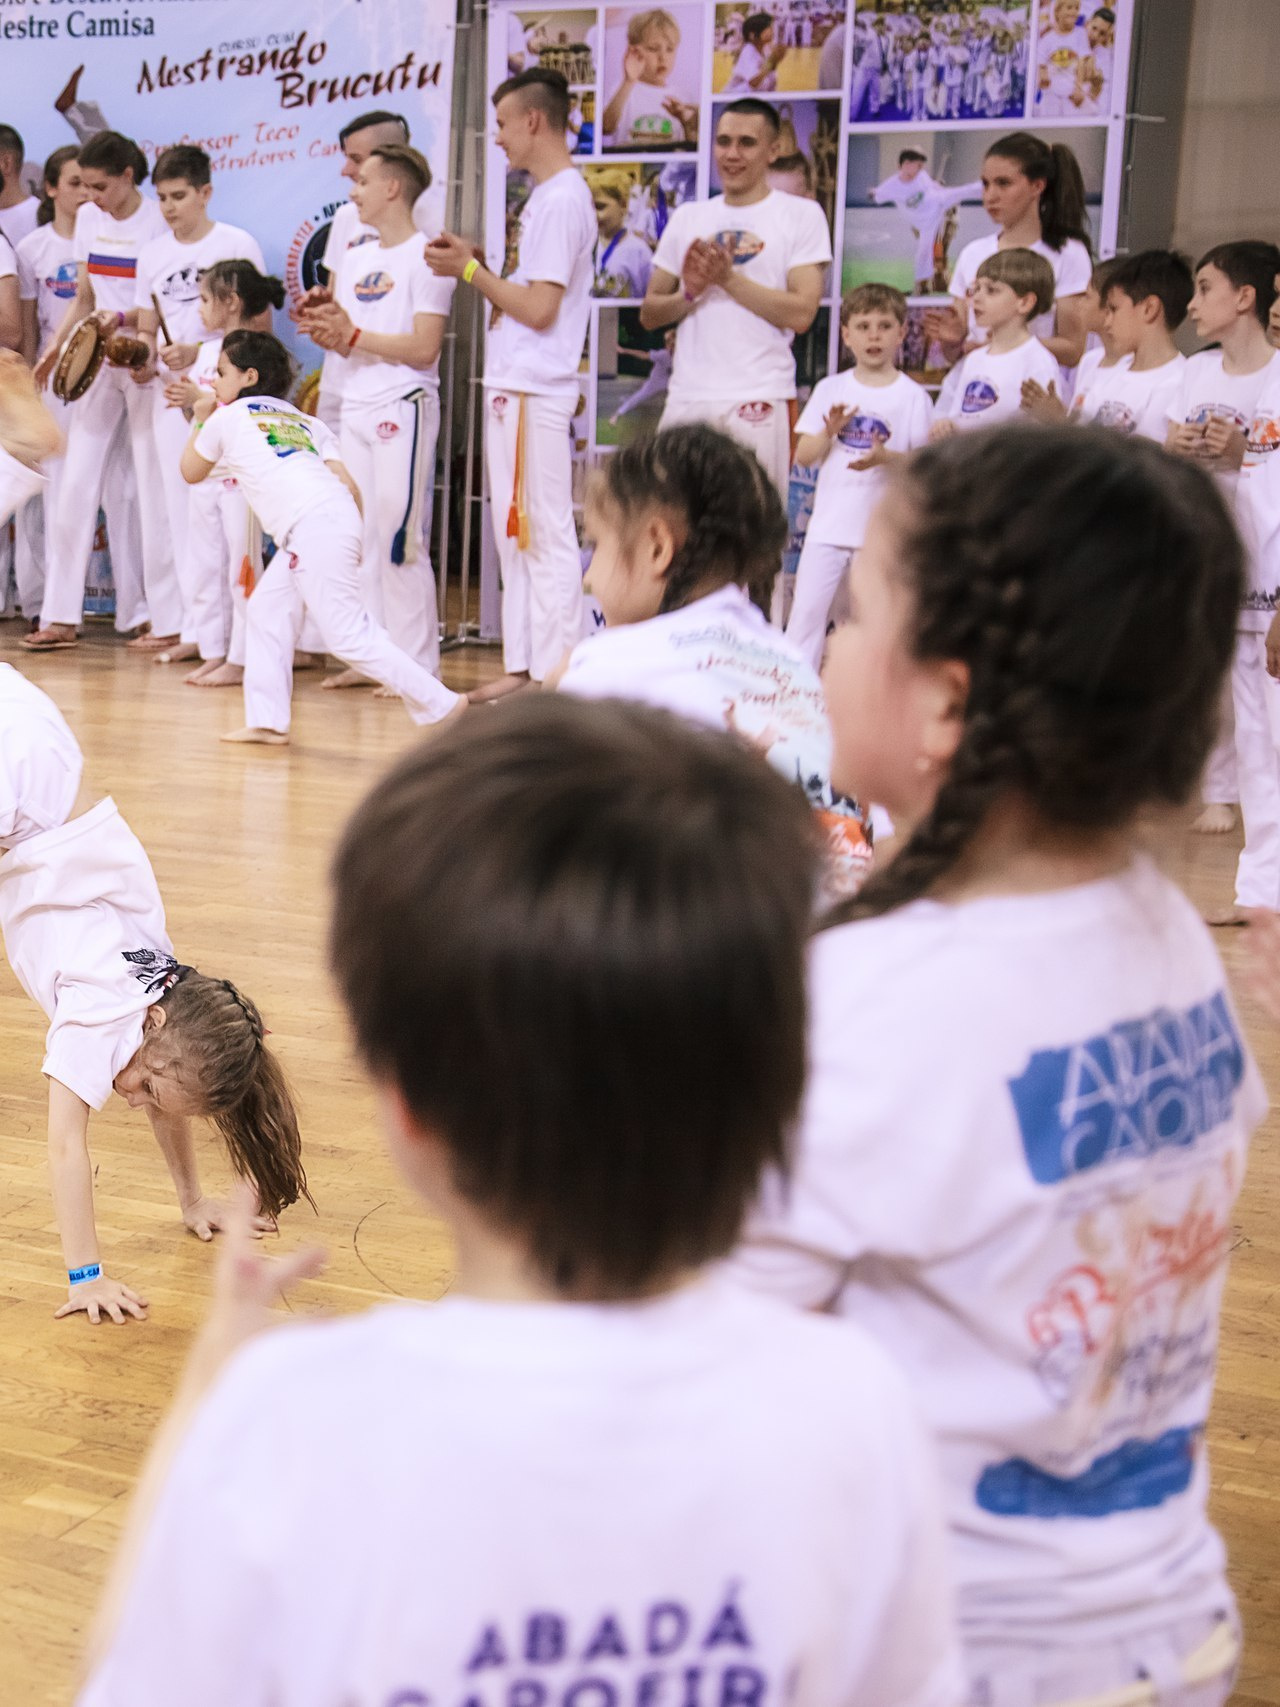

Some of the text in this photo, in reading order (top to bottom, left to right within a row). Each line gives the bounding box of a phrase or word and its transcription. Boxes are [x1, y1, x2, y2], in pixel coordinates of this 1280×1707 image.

[67, 9, 155, 38] Camisa
[136, 31, 328, 94] Mestrando
[275, 51, 443, 110] Brucutu
[462, 1576, 754, 1677] ABADÁ
[387, 1664, 770, 1707] POEIR
